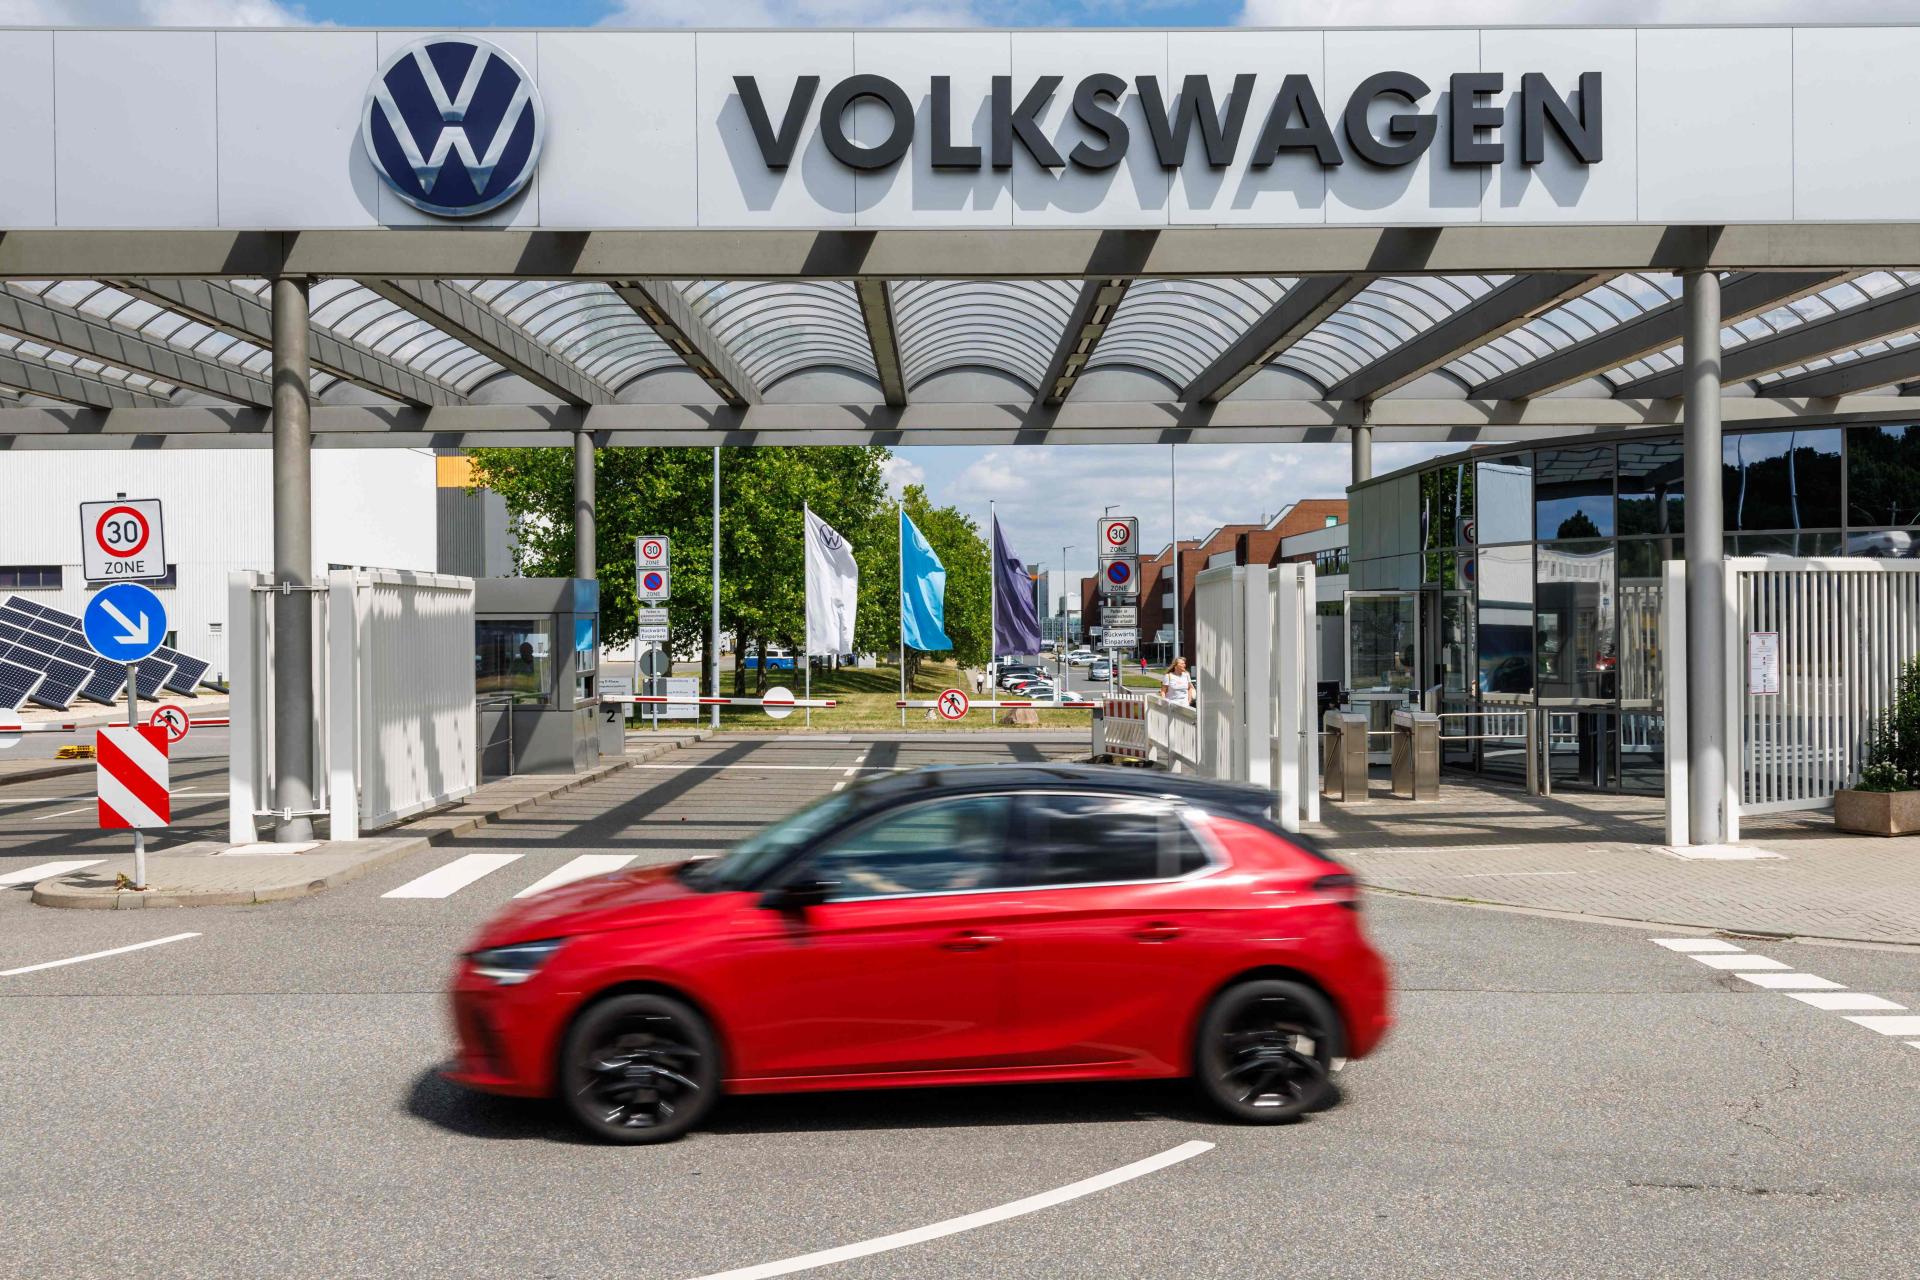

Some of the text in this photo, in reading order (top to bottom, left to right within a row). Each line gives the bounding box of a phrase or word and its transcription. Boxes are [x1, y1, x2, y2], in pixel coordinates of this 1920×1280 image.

[364, 36, 544, 216] VW
[734, 71, 1603, 169] VOLKSWAGEN
[107, 520, 138, 544] 30
[1111, 528, 1126, 540] 30
[646, 545, 658, 555] 30
[104, 560, 145, 574] ZONE
[607, 710, 615, 722] 2
